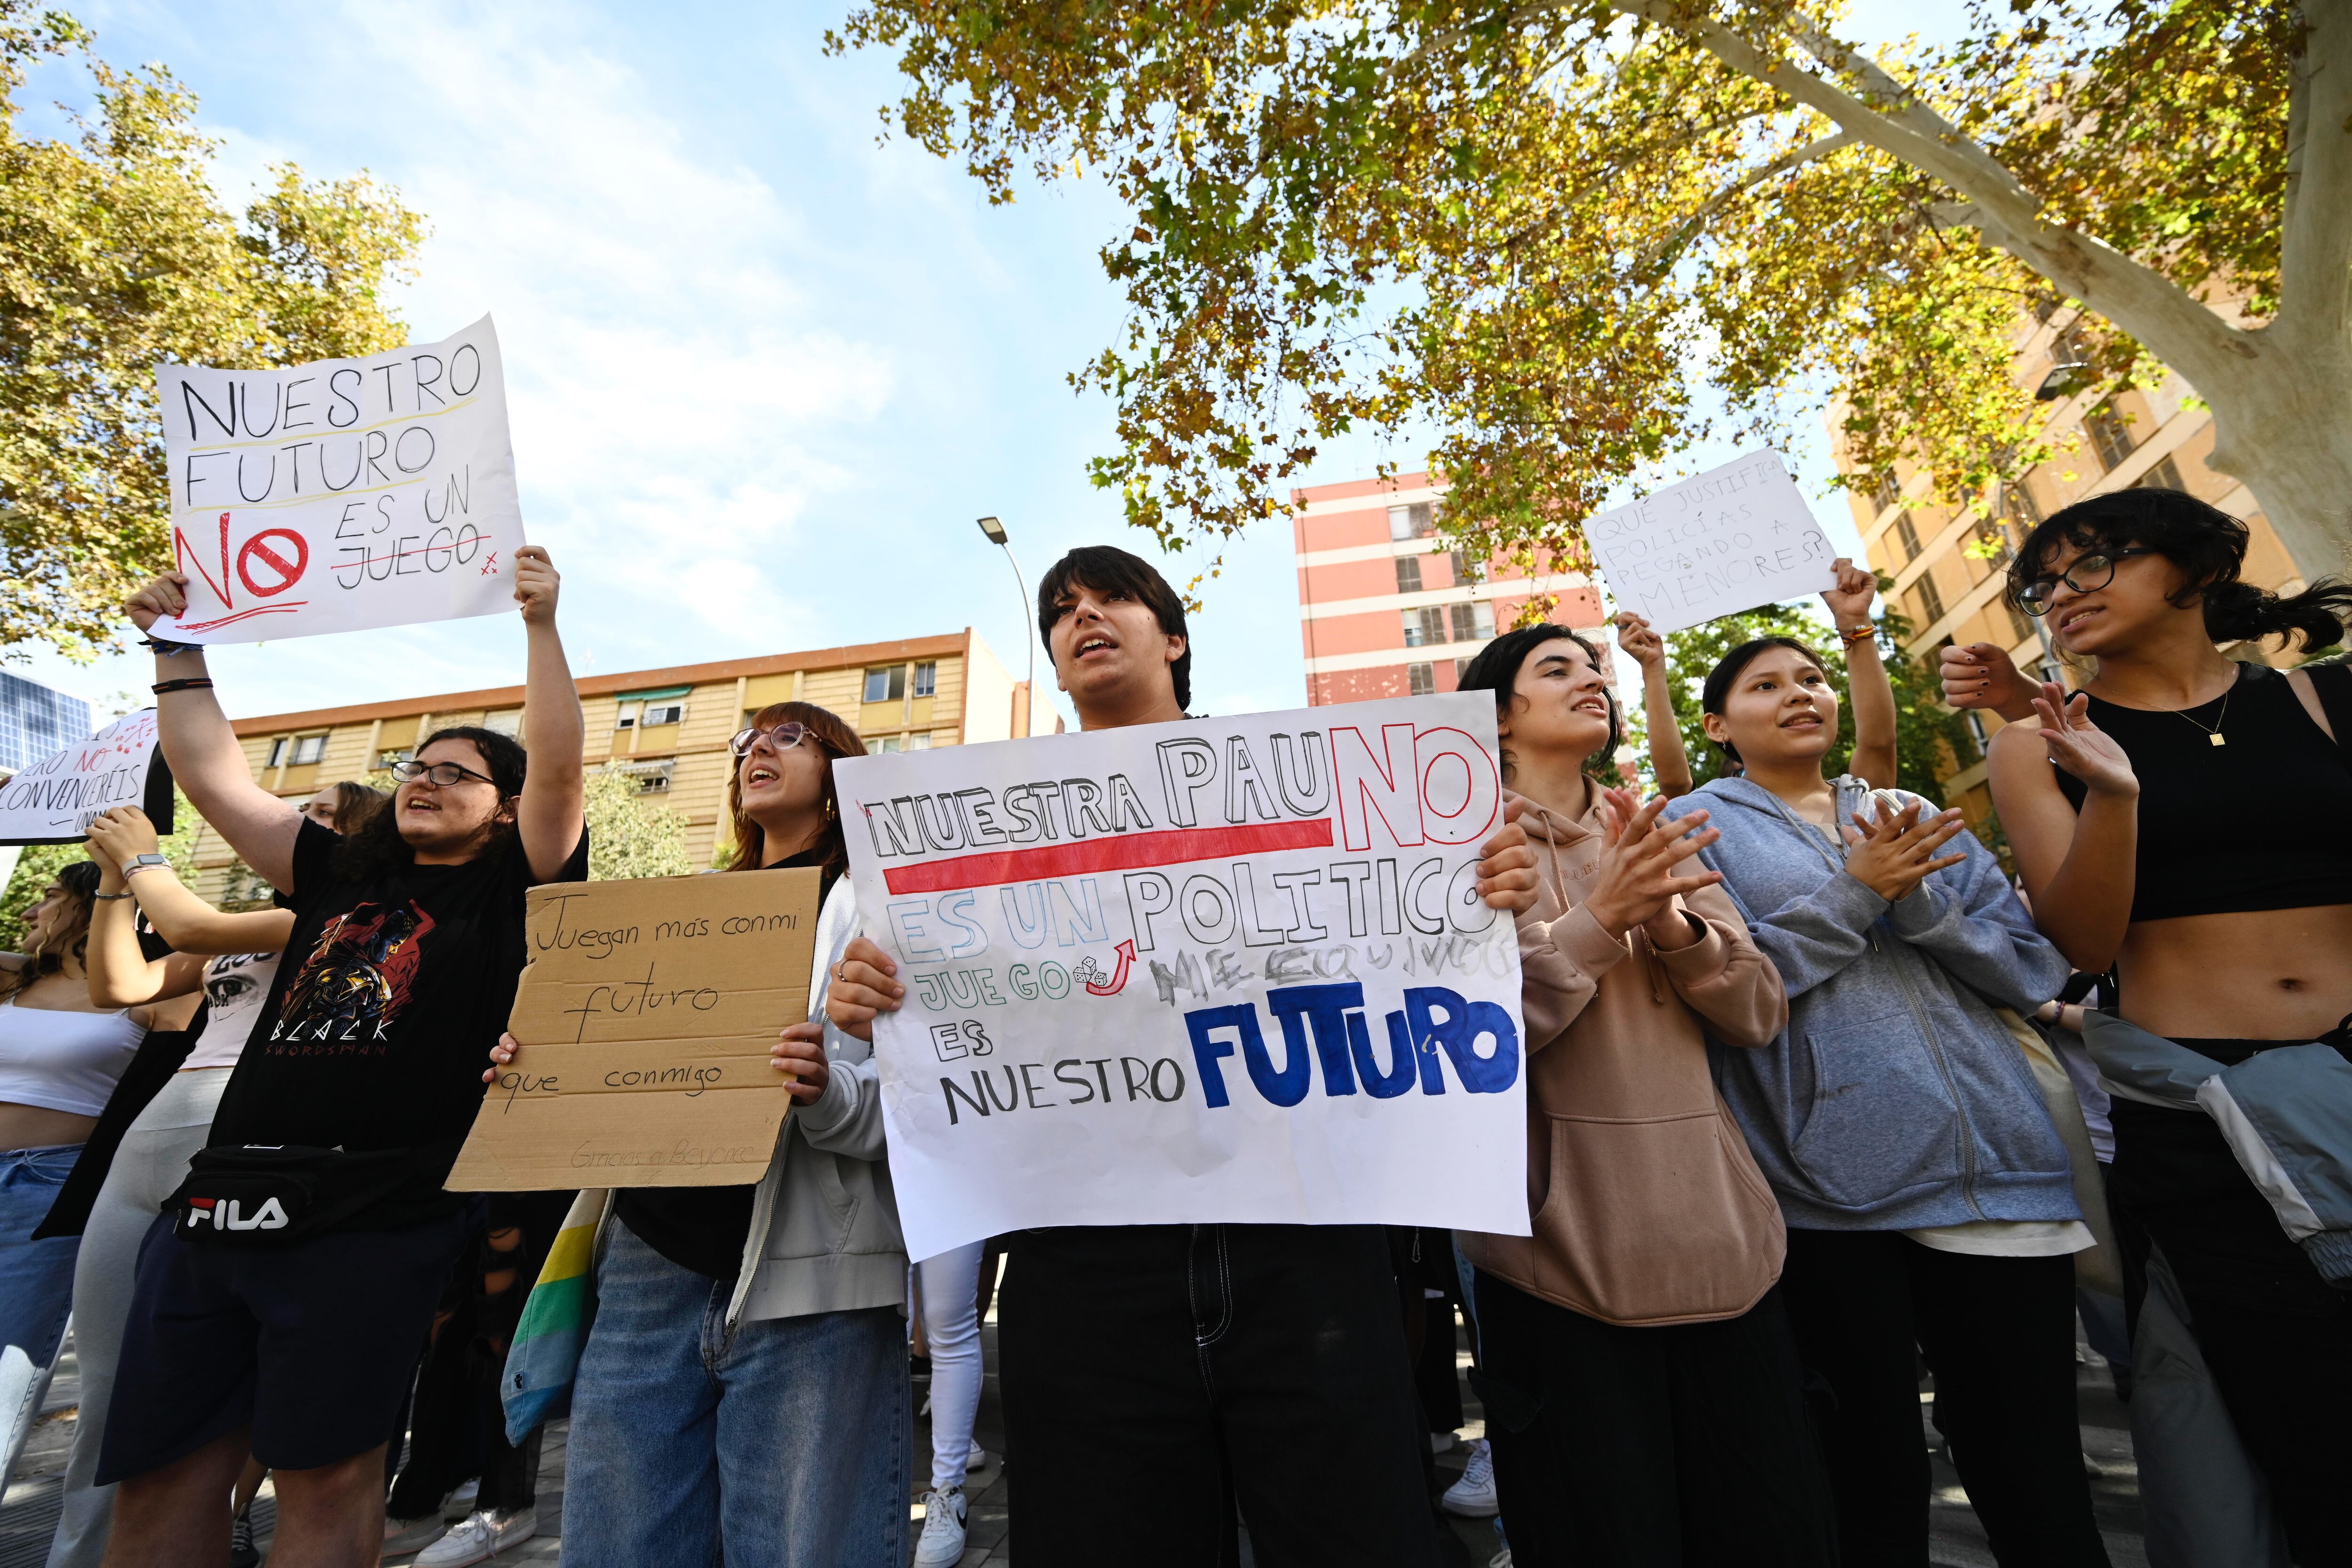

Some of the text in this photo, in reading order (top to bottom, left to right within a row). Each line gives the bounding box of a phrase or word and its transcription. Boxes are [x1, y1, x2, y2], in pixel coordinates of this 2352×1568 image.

[181, 343, 481, 441] NUESTRO
[186, 426, 435, 506] FUTURO
[334, 464, 469, 540] ES UN
[1595, 459, 1781, 541] QUÉ JUSTIFICA
[173, 512, 309, 620] NO
[336, 522, 481, 589] JUEGO
[1605, 504, 1752, 567] POLICÍAS
[1617, 519, 1789, 585] PEGANDO A
[1639, 530, 1823, 618] MENORES?
[73, 748, 111, 772] NO
[864, 723, 1499, 858] NUESTRA PAU NO
[537, 894, 638, 959] Juegan
[656, 918, 709, 941] más
[886, 858, 1498, 964] ES UN POLITICO
[564, 962, 718, 1044] futuro
[914, 961, 1070, 1011] JUEGO
[1148, 948, 1255, 1007] ME
[264, 1044, 386, 1056] SWORDSMAN
[270, 1019, 394, 1041] BLACK
[930, 1019, 993, 1062] ES
[940, 982, 1519, 1125] NUESTRO FUTURO
[501, 1065, 722, 1114] que conmigo
[571, 1139, 754, 1170] Gracias a Beyonce
[188, 1197, 289, 1231] FILA
